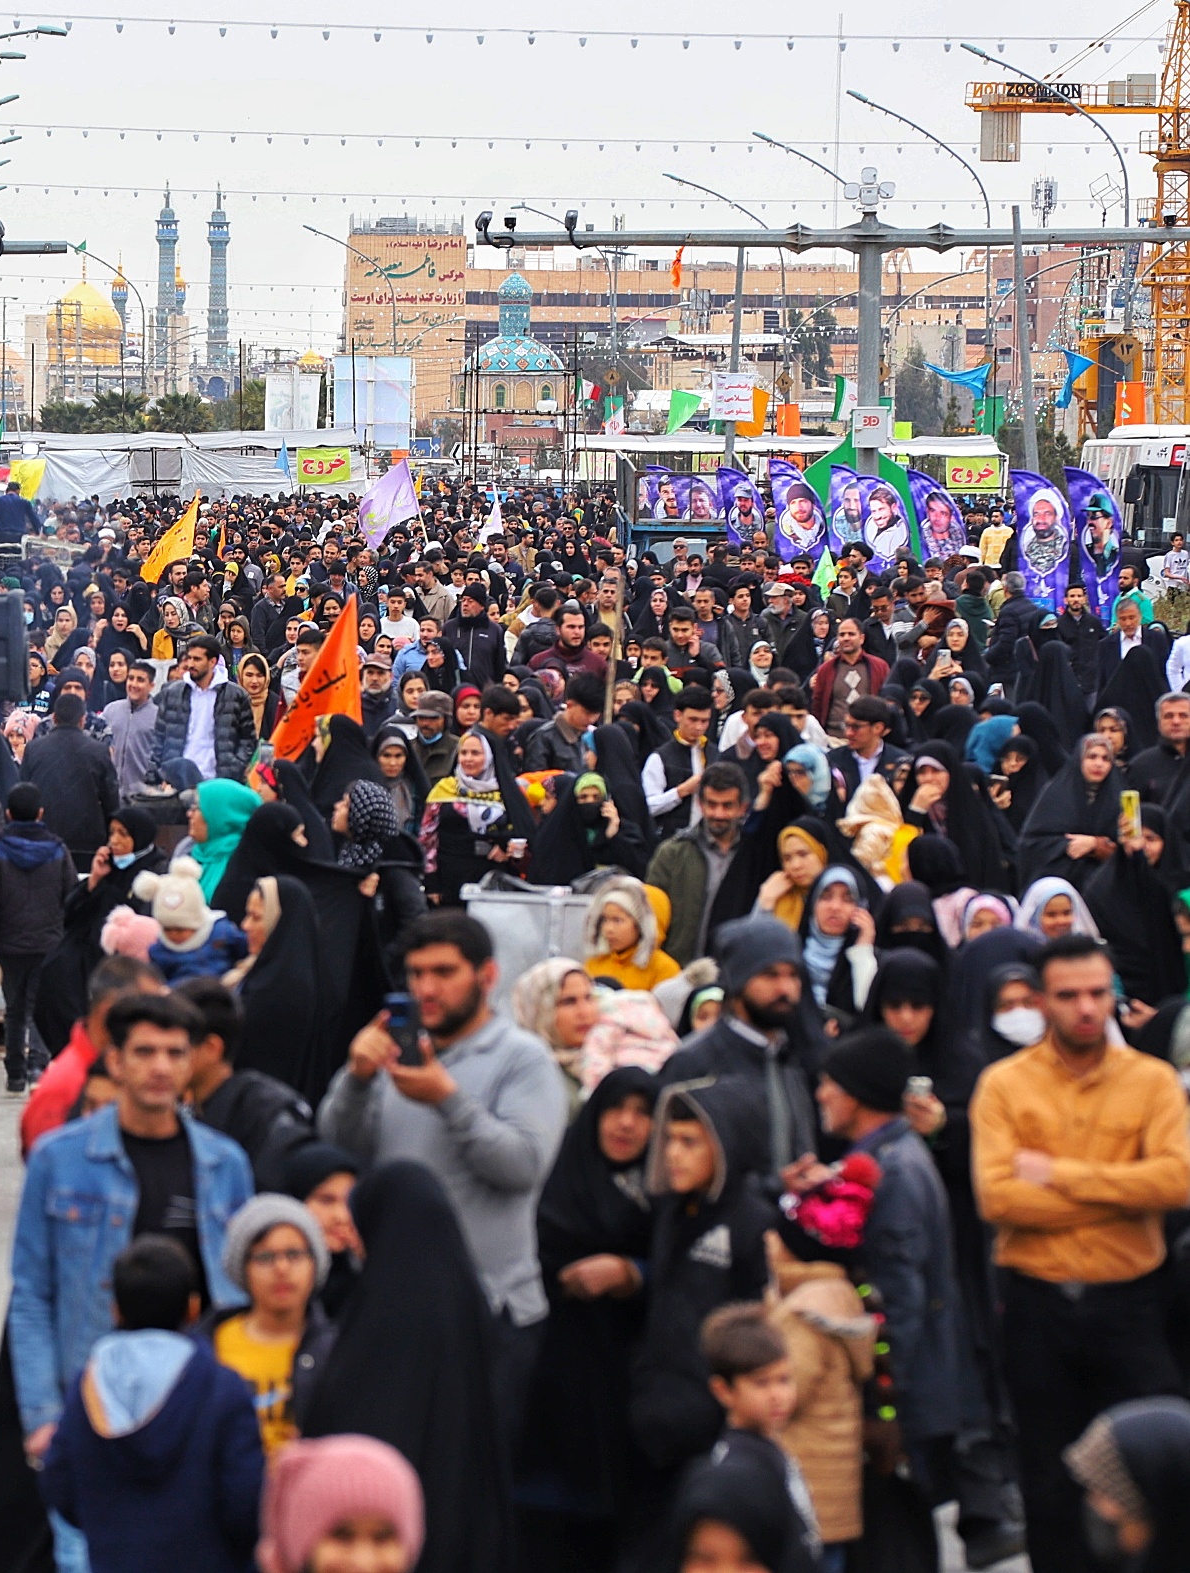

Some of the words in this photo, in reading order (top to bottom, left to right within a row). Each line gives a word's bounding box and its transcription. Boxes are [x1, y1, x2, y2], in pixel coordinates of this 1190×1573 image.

[428, 239, 442, 250] رضا
[444, 239, 462, 251] امام
[350, 292, 374, 304] اوست
[396, 292, 418, 305] بهشت
[419, 292, 434, 302] کند
[435, 292, 457, 304] زیارت
[302, 453, 346, 475] خروج
[951, 462, 995, 483] خروج
